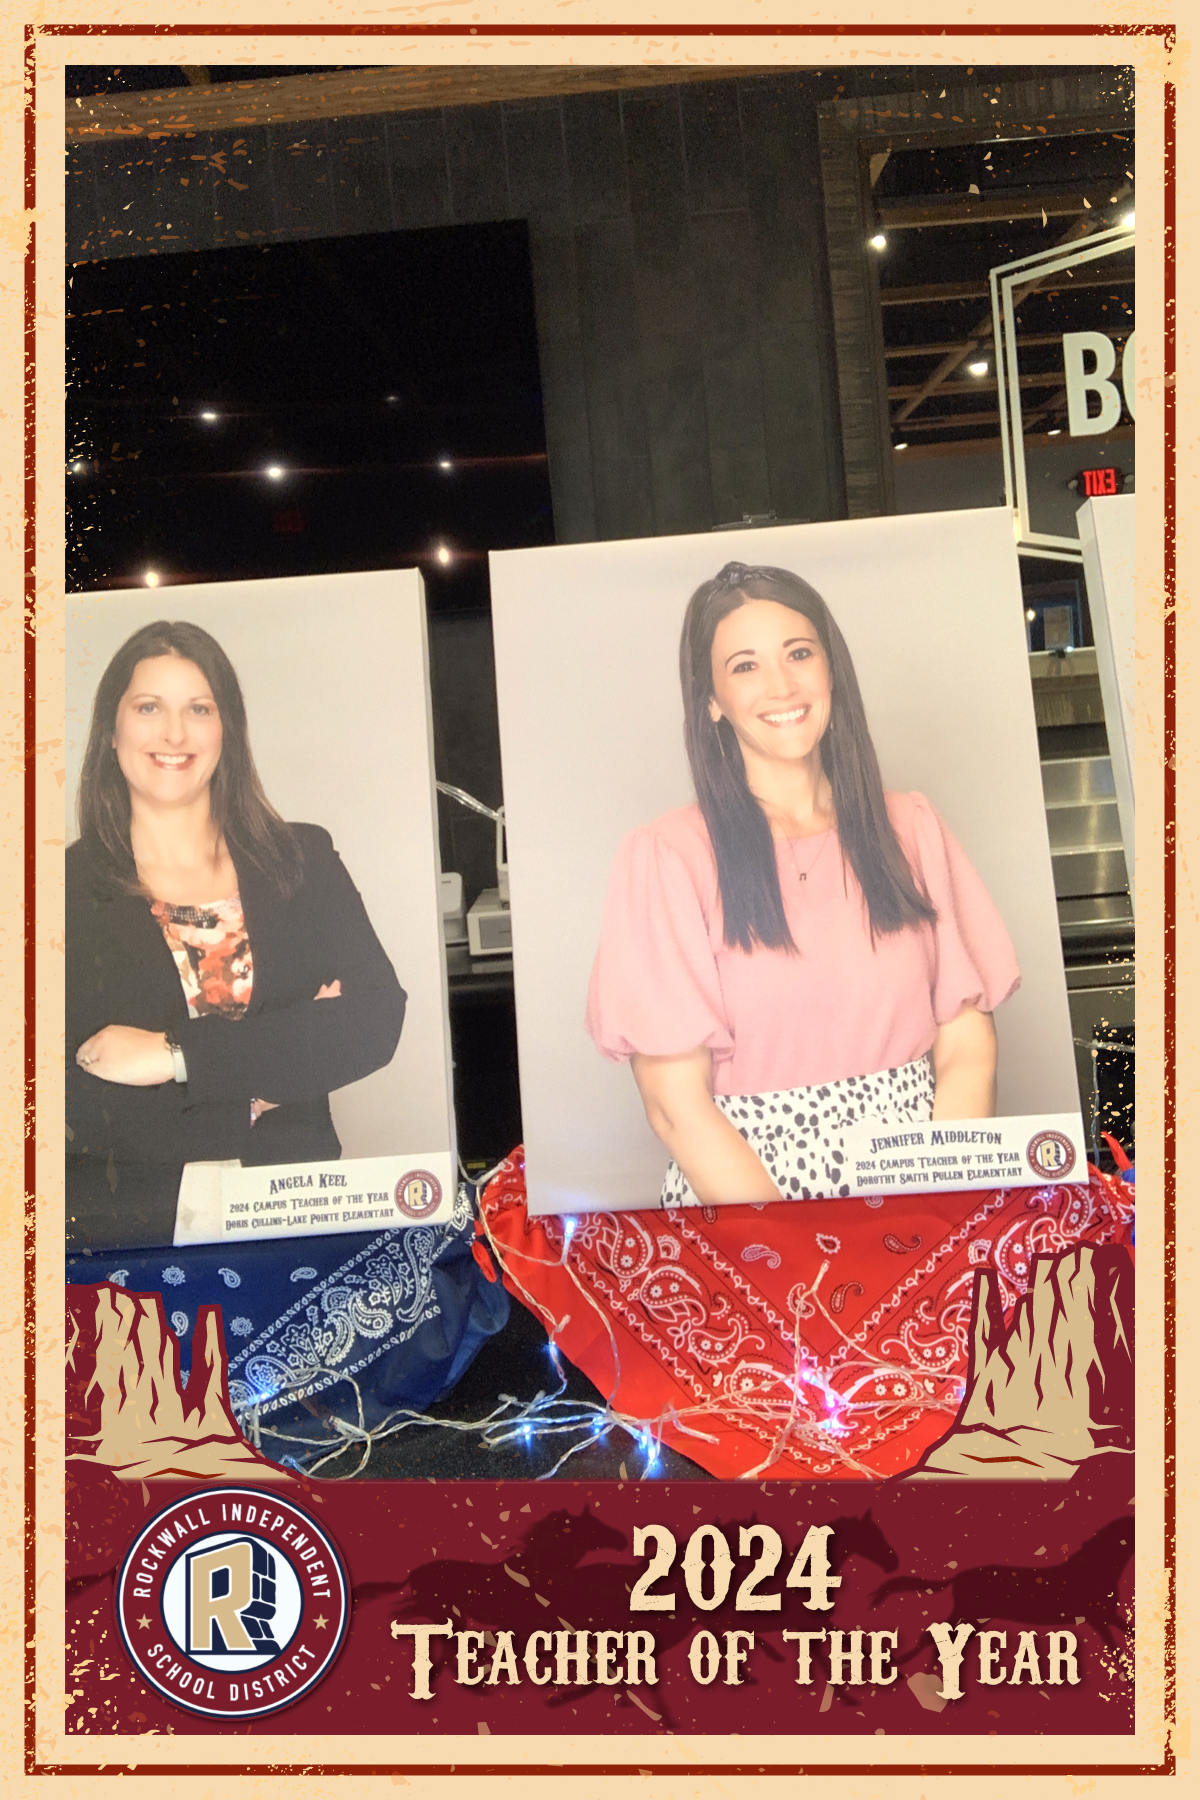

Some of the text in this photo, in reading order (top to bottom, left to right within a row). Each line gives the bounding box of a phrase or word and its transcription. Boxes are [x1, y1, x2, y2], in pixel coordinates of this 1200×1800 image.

[1062, 331, 1135, 437] B
[870, 1130, 1002, 1154] JENNIFER MIDDLETON
[855, 1152, 1020, 1171] 2024 CAMPUS TEACHER OF THE YEAR
[269, 1173, 347, 1195] ANGELA KEEL
[856, 1167, 1023, 1187] DOROTHY SMITH PULLEN ELEMENTARY
[229, 1192, 389, 1213] 2024 CAMPUS TEACHER OF THE YEAR
[225, 1219, 249, 1231] DORIS
[310, 1212, 340, 1225] POINTE
[342, 1208, 394, 1223] ELEMENTARY
